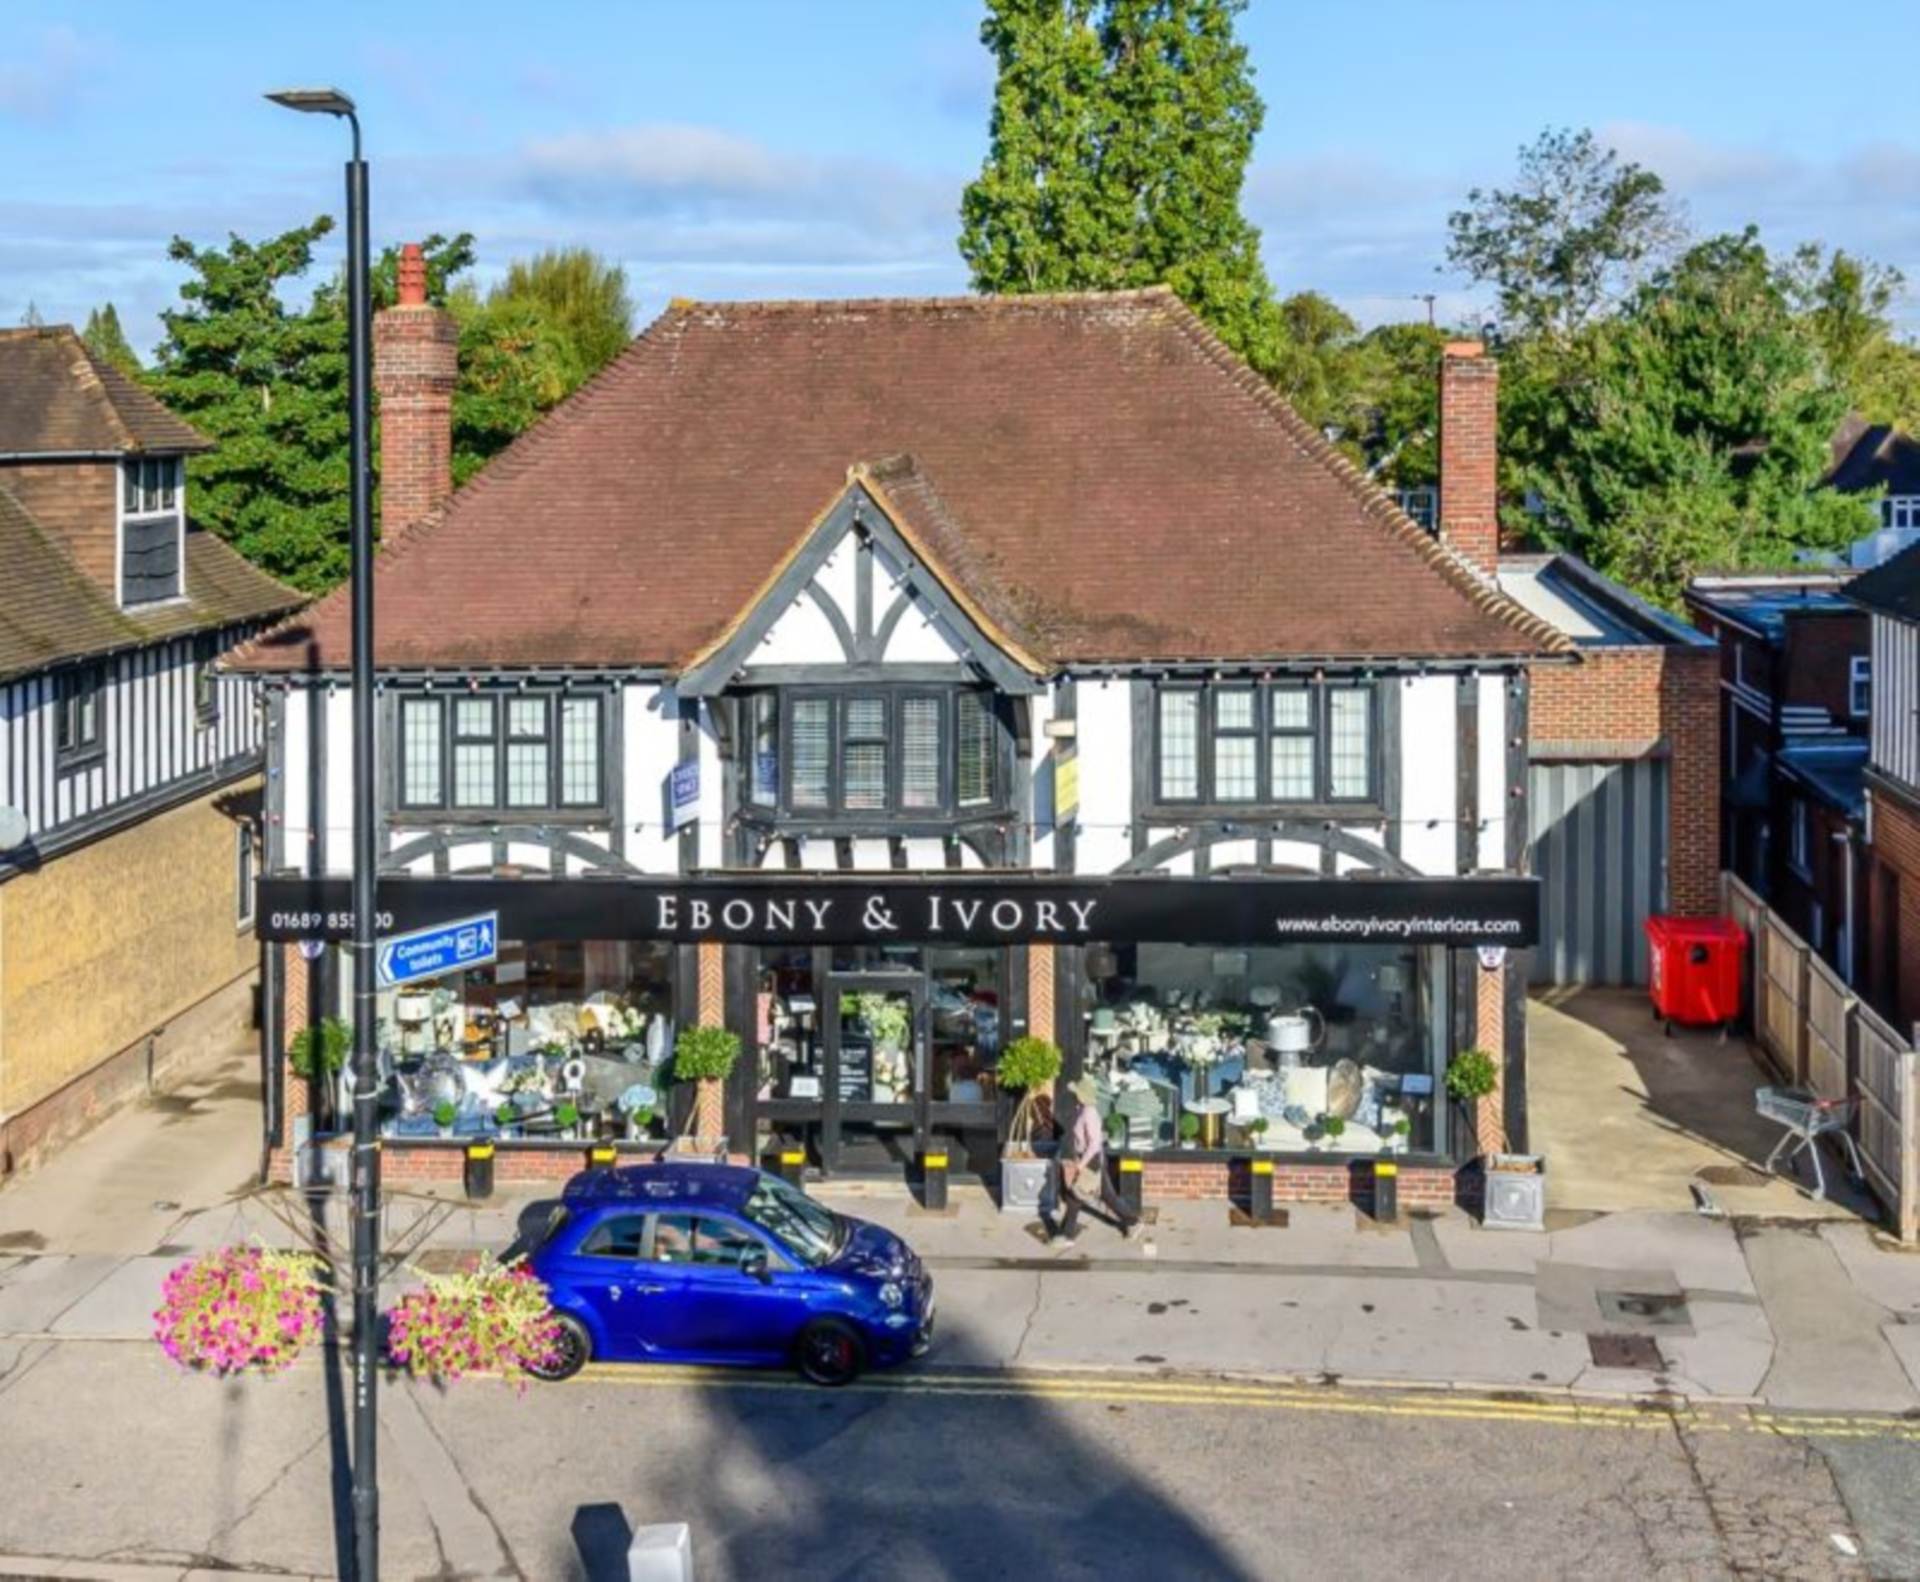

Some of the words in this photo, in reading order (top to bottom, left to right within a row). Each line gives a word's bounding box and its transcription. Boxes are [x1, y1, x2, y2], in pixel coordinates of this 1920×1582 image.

[272, 911, 322, 929] 01689
[862, 896, 898, 930] &
[928, 895, 1098, 930] IVORY
[1277, 915, 1520, 936] www.ebonyivoryinteriors.com
